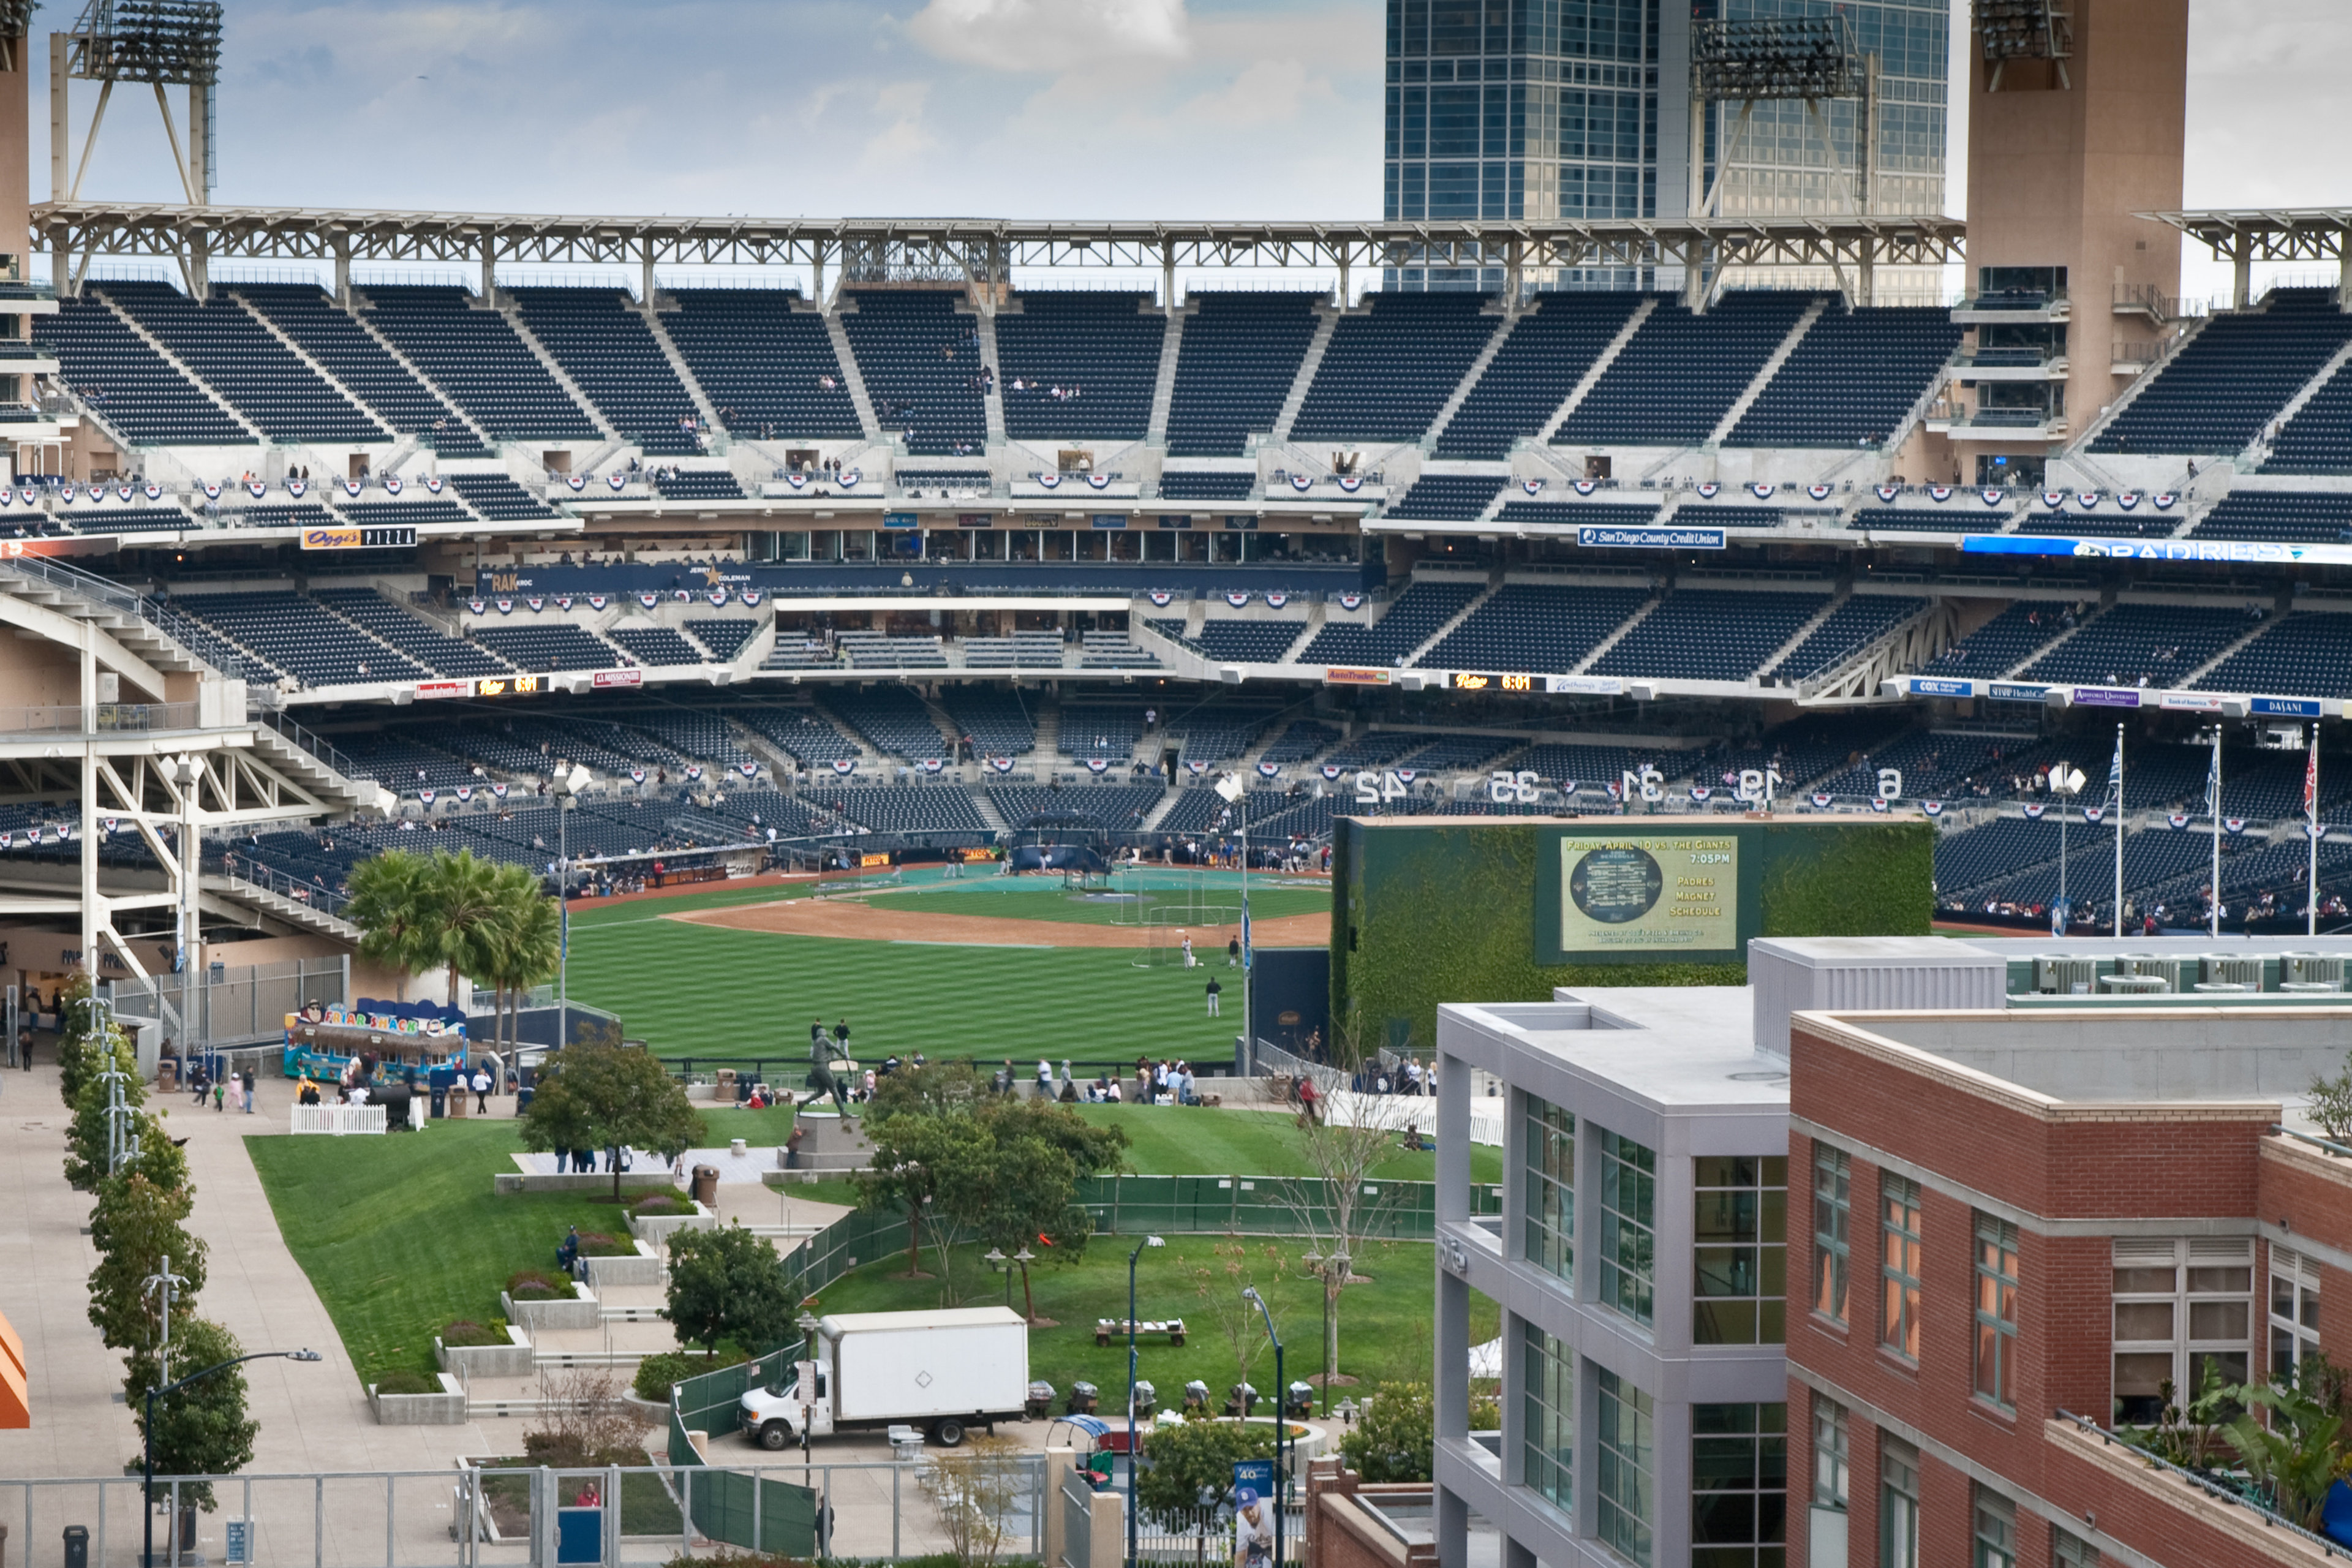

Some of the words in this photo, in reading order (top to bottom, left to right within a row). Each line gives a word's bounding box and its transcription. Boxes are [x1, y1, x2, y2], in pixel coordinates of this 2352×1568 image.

[366, 530, 412, 545] PIZZA
[1599, 531, 1615, 542] San
[1615, 531, 1640, 545] Diego
[1640, 532, 1669, 545] County
[1670, 532, 1694, 543] Credit
[1695, 533, 1719, 545] Union
[2111, 543, 2283, 561] PADRES
[492, 573, 519, 592] RAK
[514, 677, 537, 692] 6:01
[1501, 675, 1531, 690] 6:01
[1919, 681, 1940, 692] COX
[2013, 689, 2045, 699] HealthCar
[2269, 701, 2302, 713] DASANI
[1605, 841, 1634, 850] APRIL
[1638, 840, 1651, 850] 10
[1695, 840, 1731, 850] GIANTS
[1690, 854, 1730, 864] 7:05PM
[1677, 876, 1714, 886] PADRES
[1675, 892, 1716, 902] MAGNET
[1669, 907, 1721, 916] SCHEDULE
[325, 1011, 366, 1026] FRIAR
[370, 1016, 417, 1032] SHACK
[1240, 1469, 1256, 1480] 40
